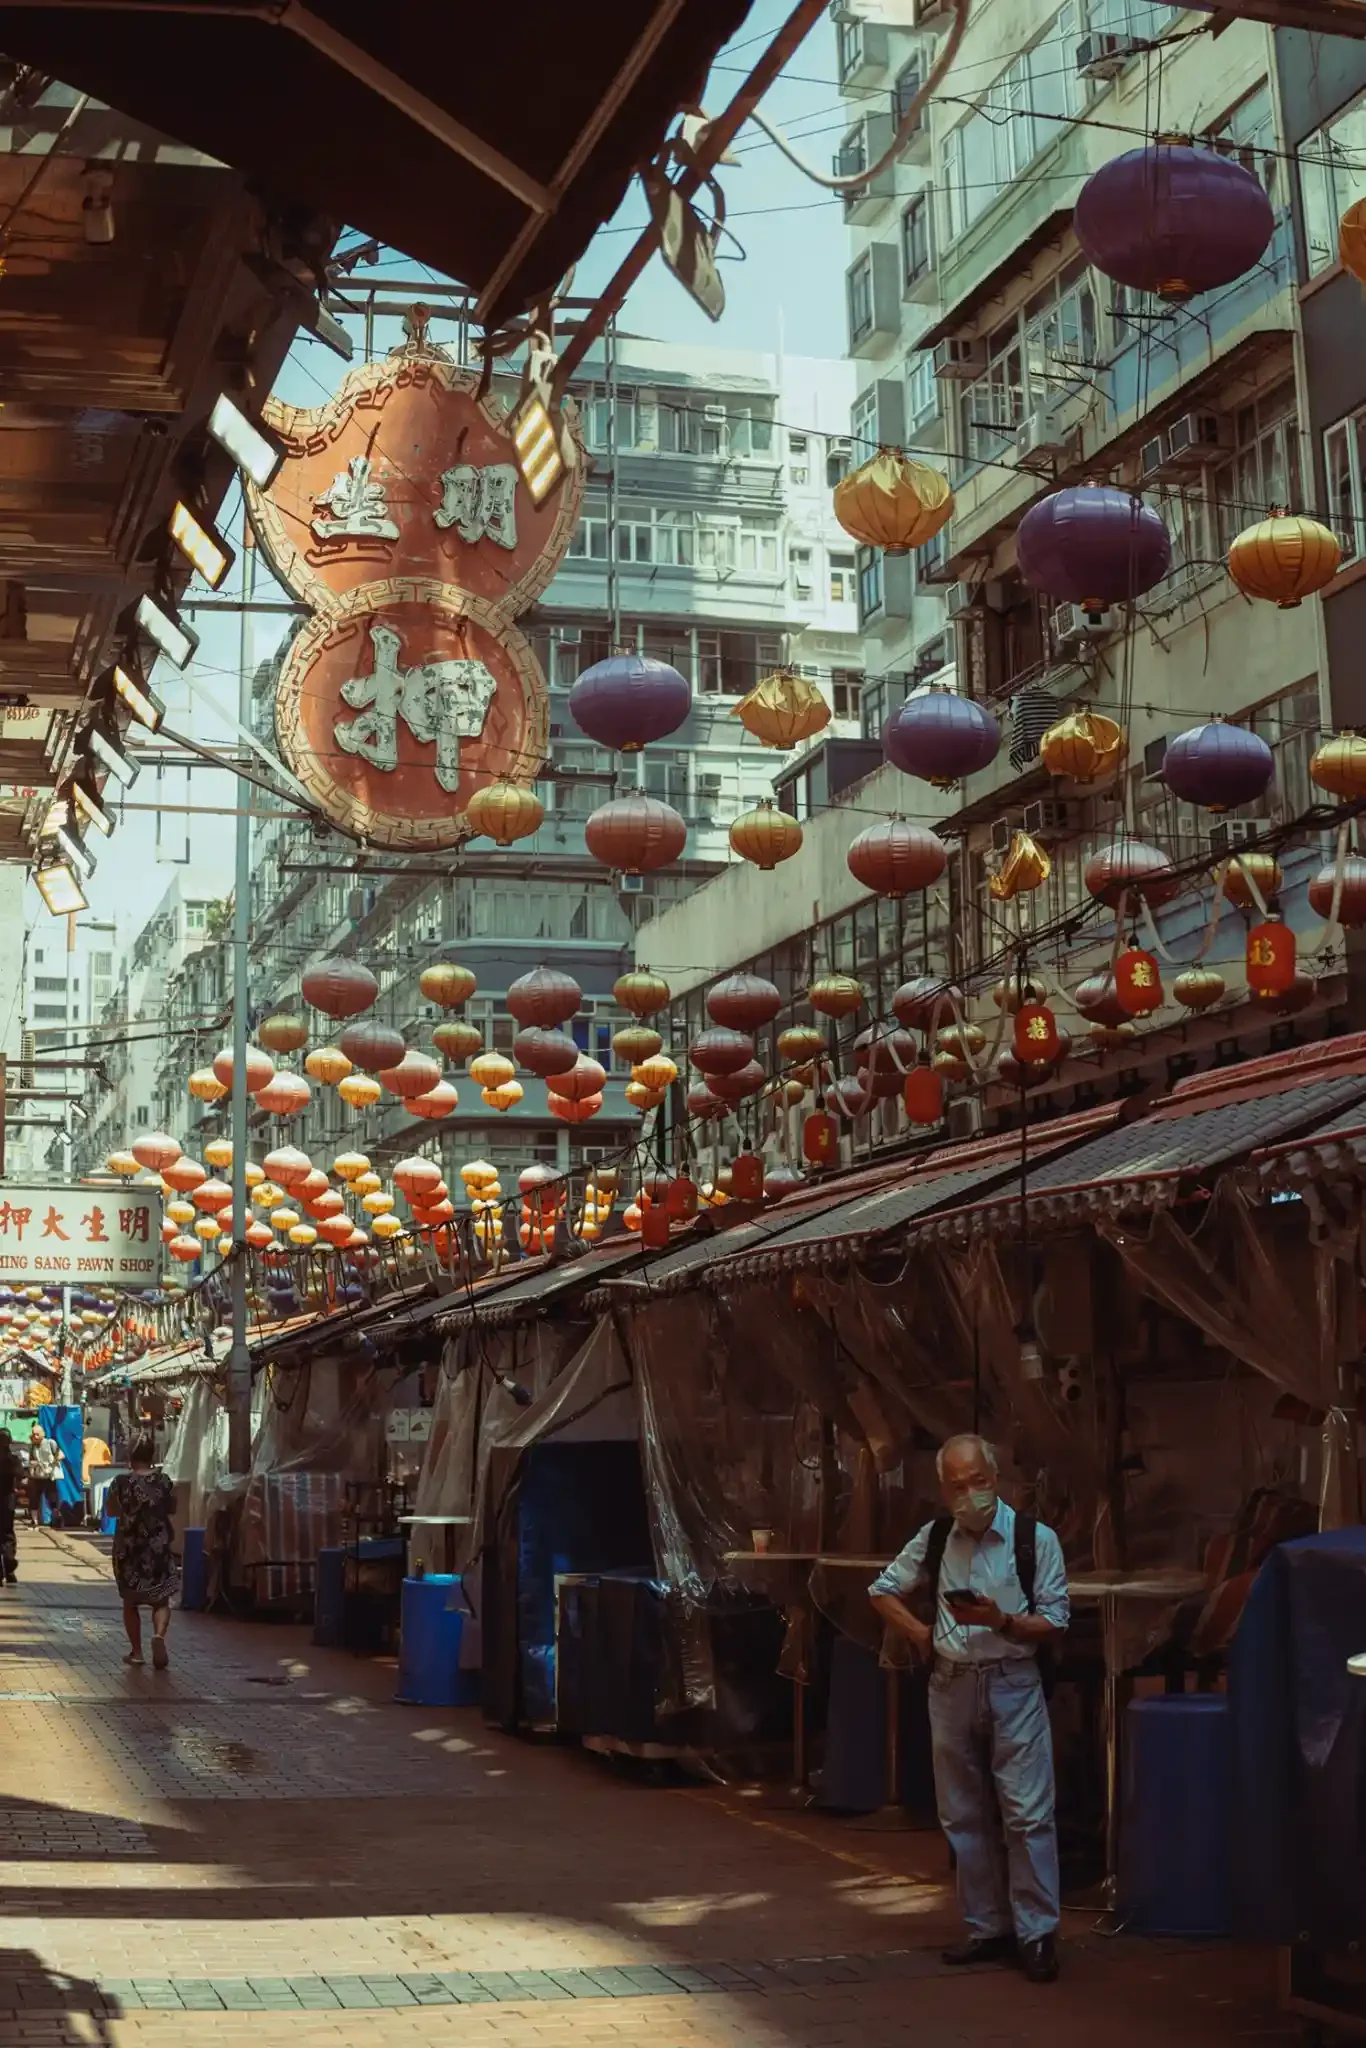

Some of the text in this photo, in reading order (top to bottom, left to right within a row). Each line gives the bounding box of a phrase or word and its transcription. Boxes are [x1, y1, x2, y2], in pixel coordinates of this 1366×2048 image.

[334, 624, 498, 793] 押
[34, 1256, 71, 1270] SANG
[77, 1257, 114, 1272] PAWN
[120, 1258, 155, 1272] SHOP
